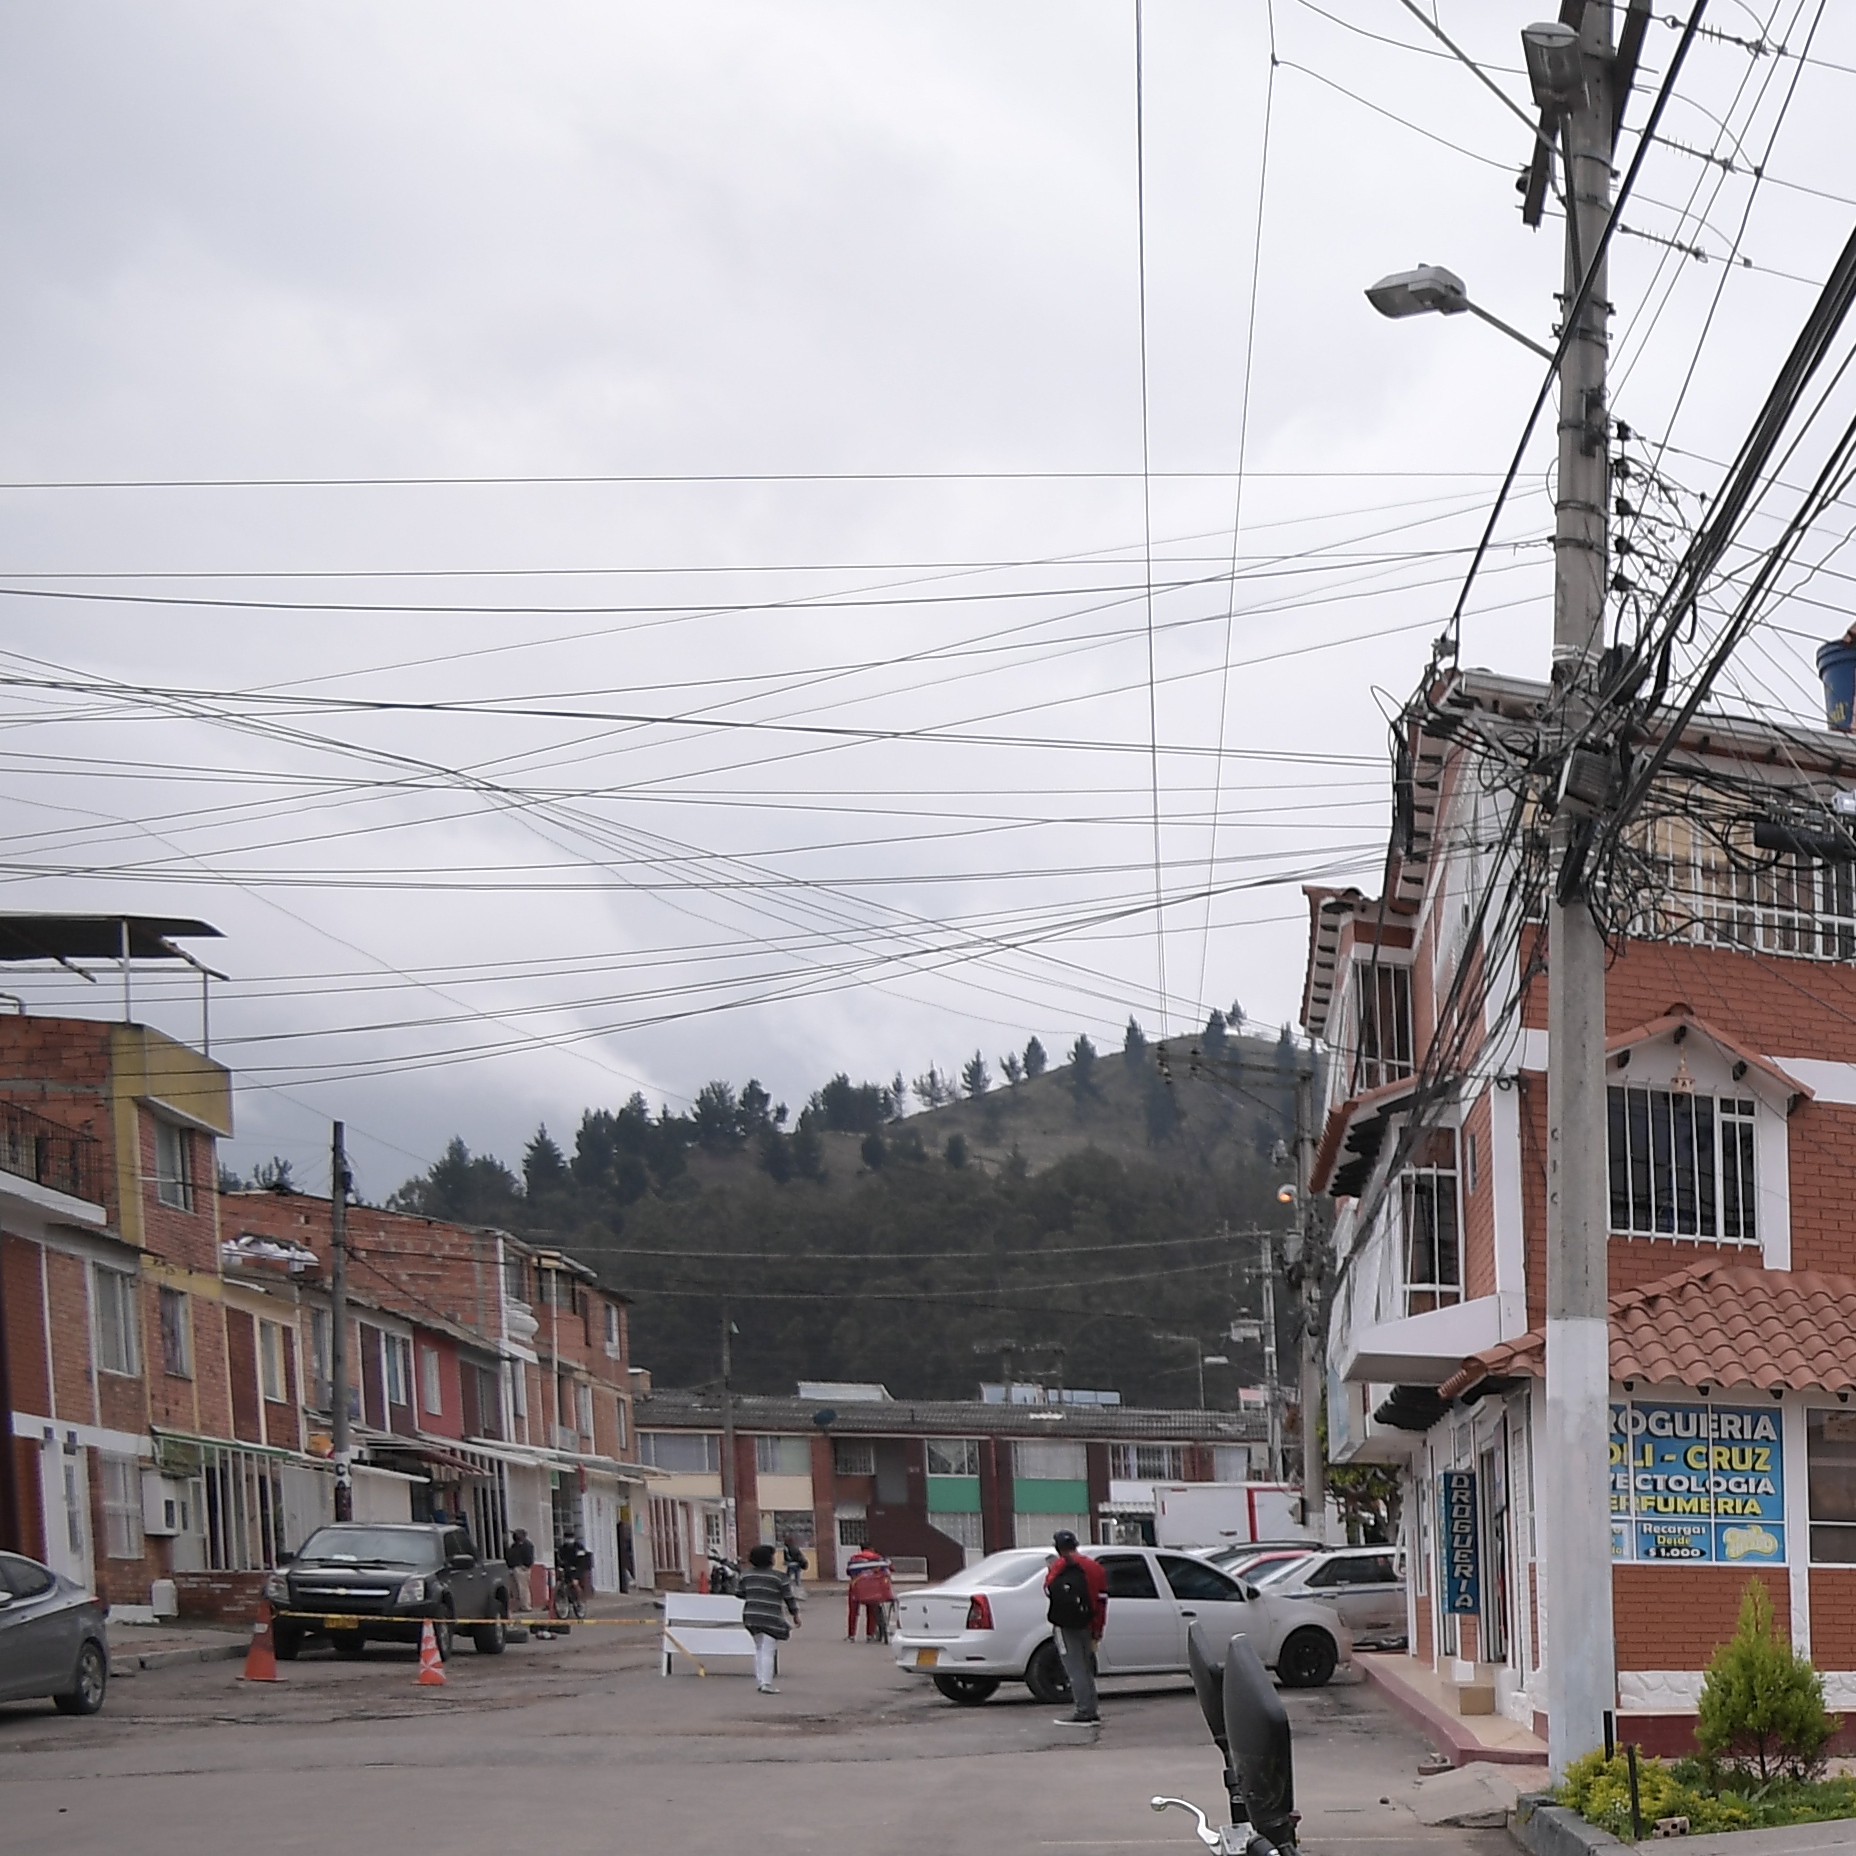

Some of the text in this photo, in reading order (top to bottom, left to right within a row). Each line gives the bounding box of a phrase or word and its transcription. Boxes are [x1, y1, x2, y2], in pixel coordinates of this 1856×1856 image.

[1609, 1408, 1777, 1441] ROGUERIA
[1609, 1442, 1654, 1469] OLI
[1686, 1444, 1772, 1472] CRUZ
[1610, 1473, 1776, 1495] ECTOLOGIA
[1610, 1495, 1762, 1515] ERFUMERIA
[1450, 1475, 1474, 1608] DROGUERIA
[1660, 1548, 1701, 1557] 1.000
